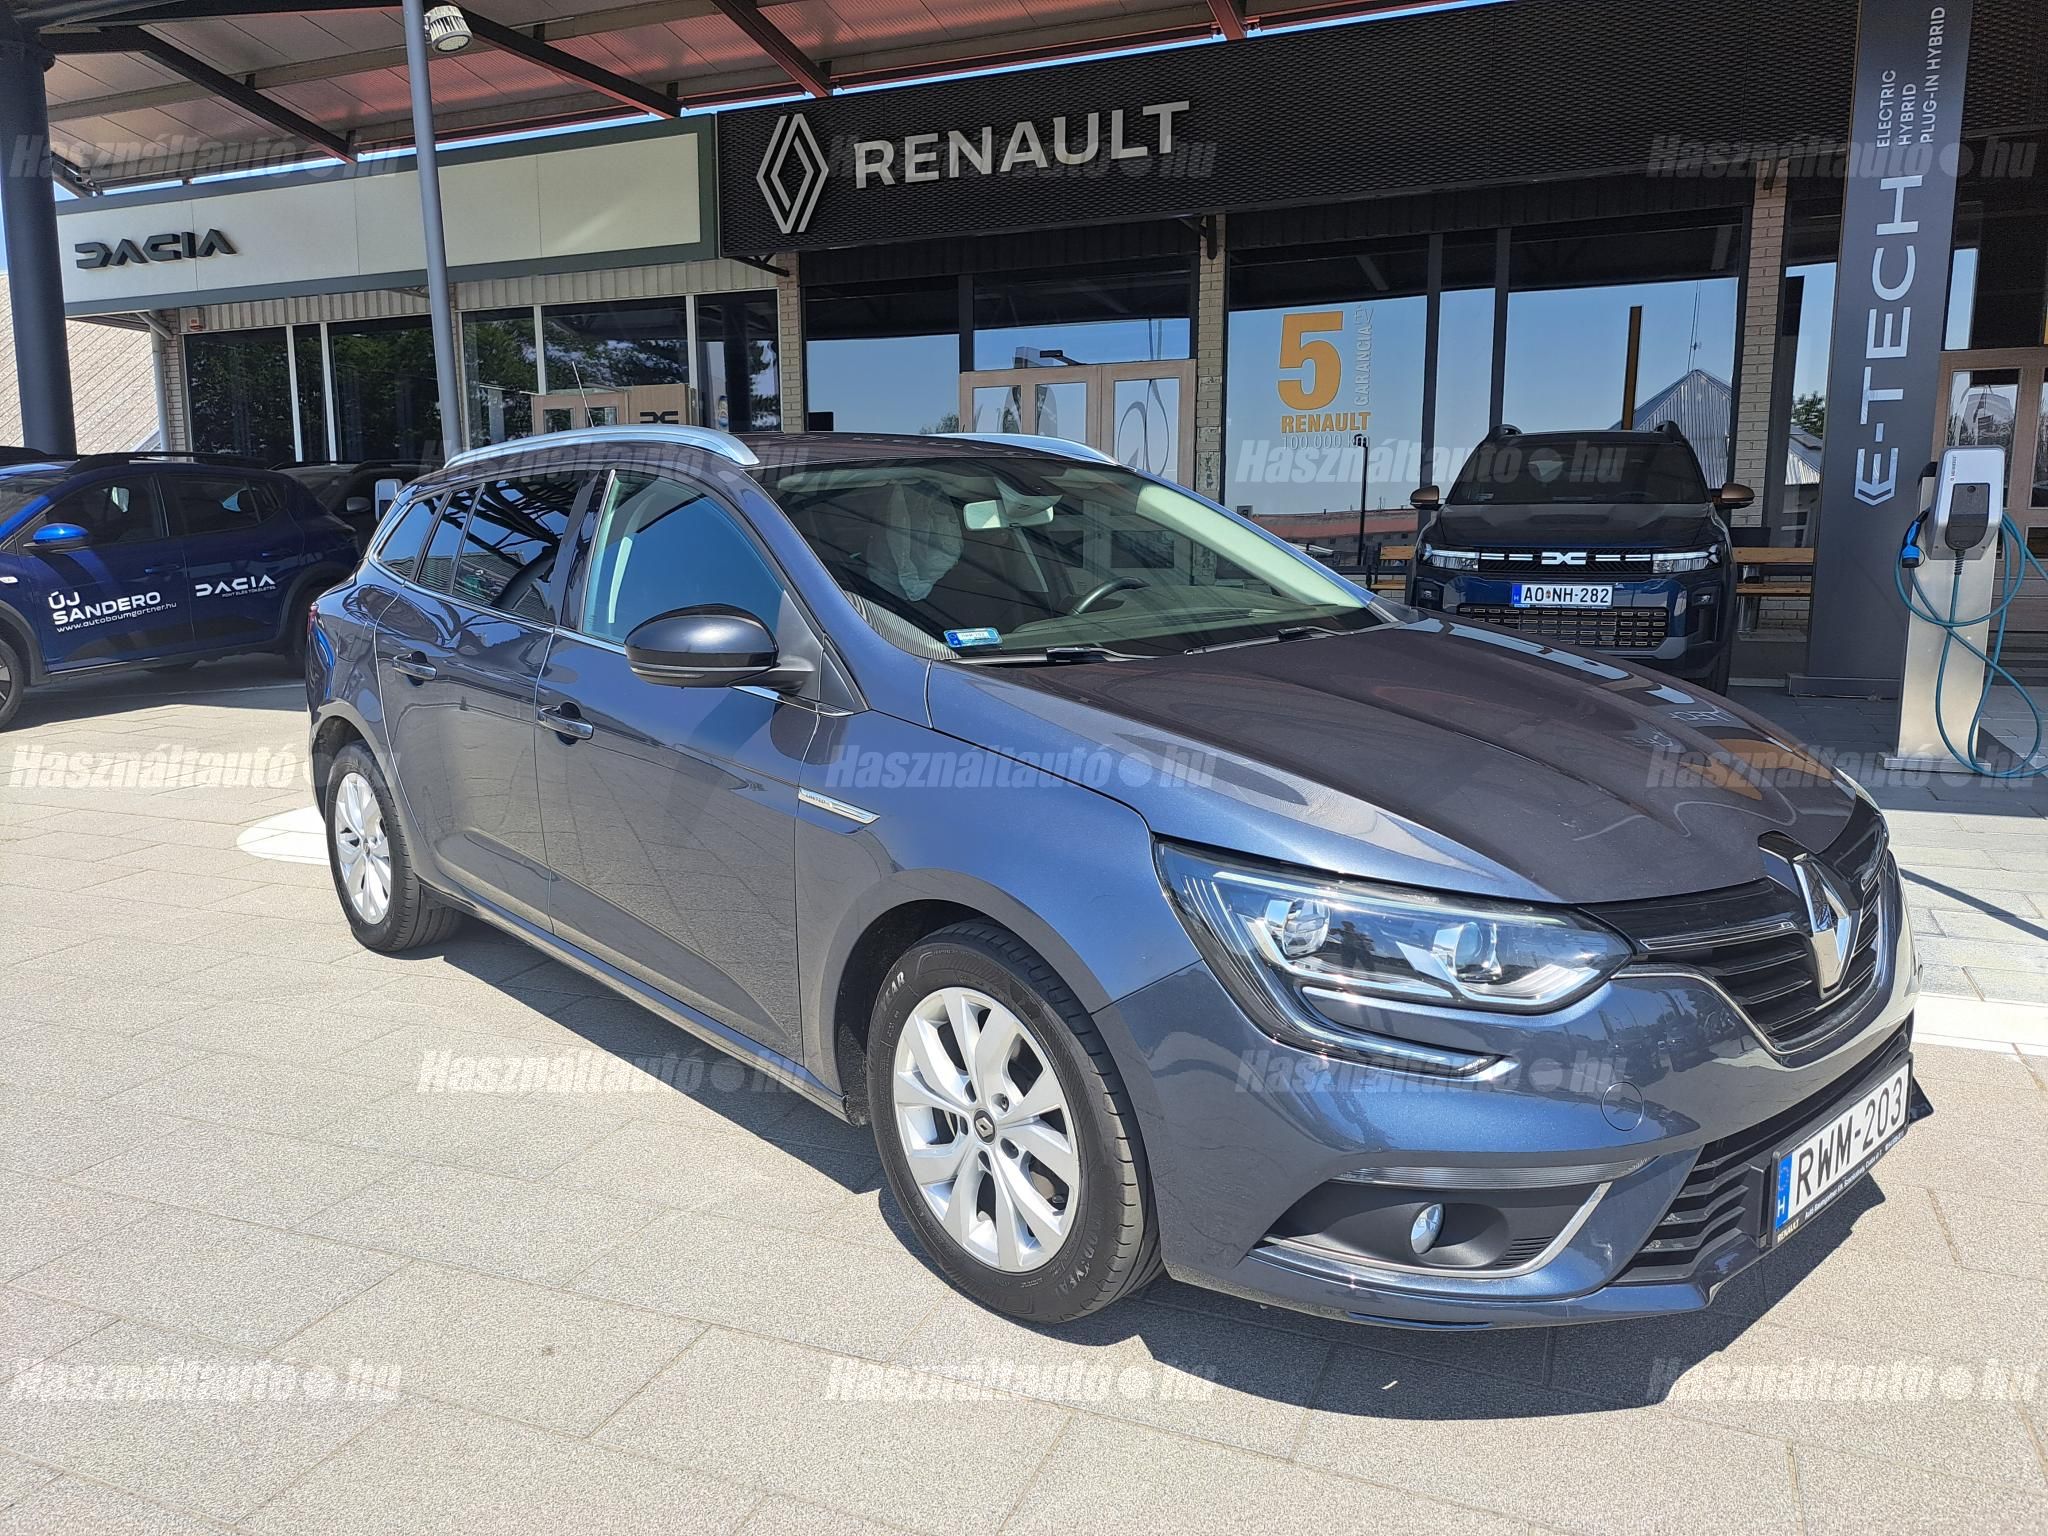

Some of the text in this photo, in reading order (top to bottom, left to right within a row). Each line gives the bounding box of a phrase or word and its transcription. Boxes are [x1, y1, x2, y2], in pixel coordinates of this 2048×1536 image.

[1920, 7, 1945, 143] PLUG-IN HYBRID
[1877, 70, 1896, 147] ELECTRIC
[1898, 83, 1916, 146] HYBRID
[853, 100, 1190, 189] RENAULT
[75, 228, 237, 269] DACIA
[1278, 311, 1344, 411] 5
[1354, 325, 1373, 407] GARANCIA
[1854, 174, 1923, 506] E-TECH
[1281, 412, 1371, 433] RENAULT
[48, 591, 80, 610] ÚJ
[52, 591, 161, 626] SANDERO
[195, 574, 276, 597] DACIA
[1552, 587, 1609, 603] NH-282
[56, 601, 177, 633] www.autobaumgartner.hu
[1796, 1076, 1903, 1207] RWM-203
[1776, 1195, 1786, 1218] H
